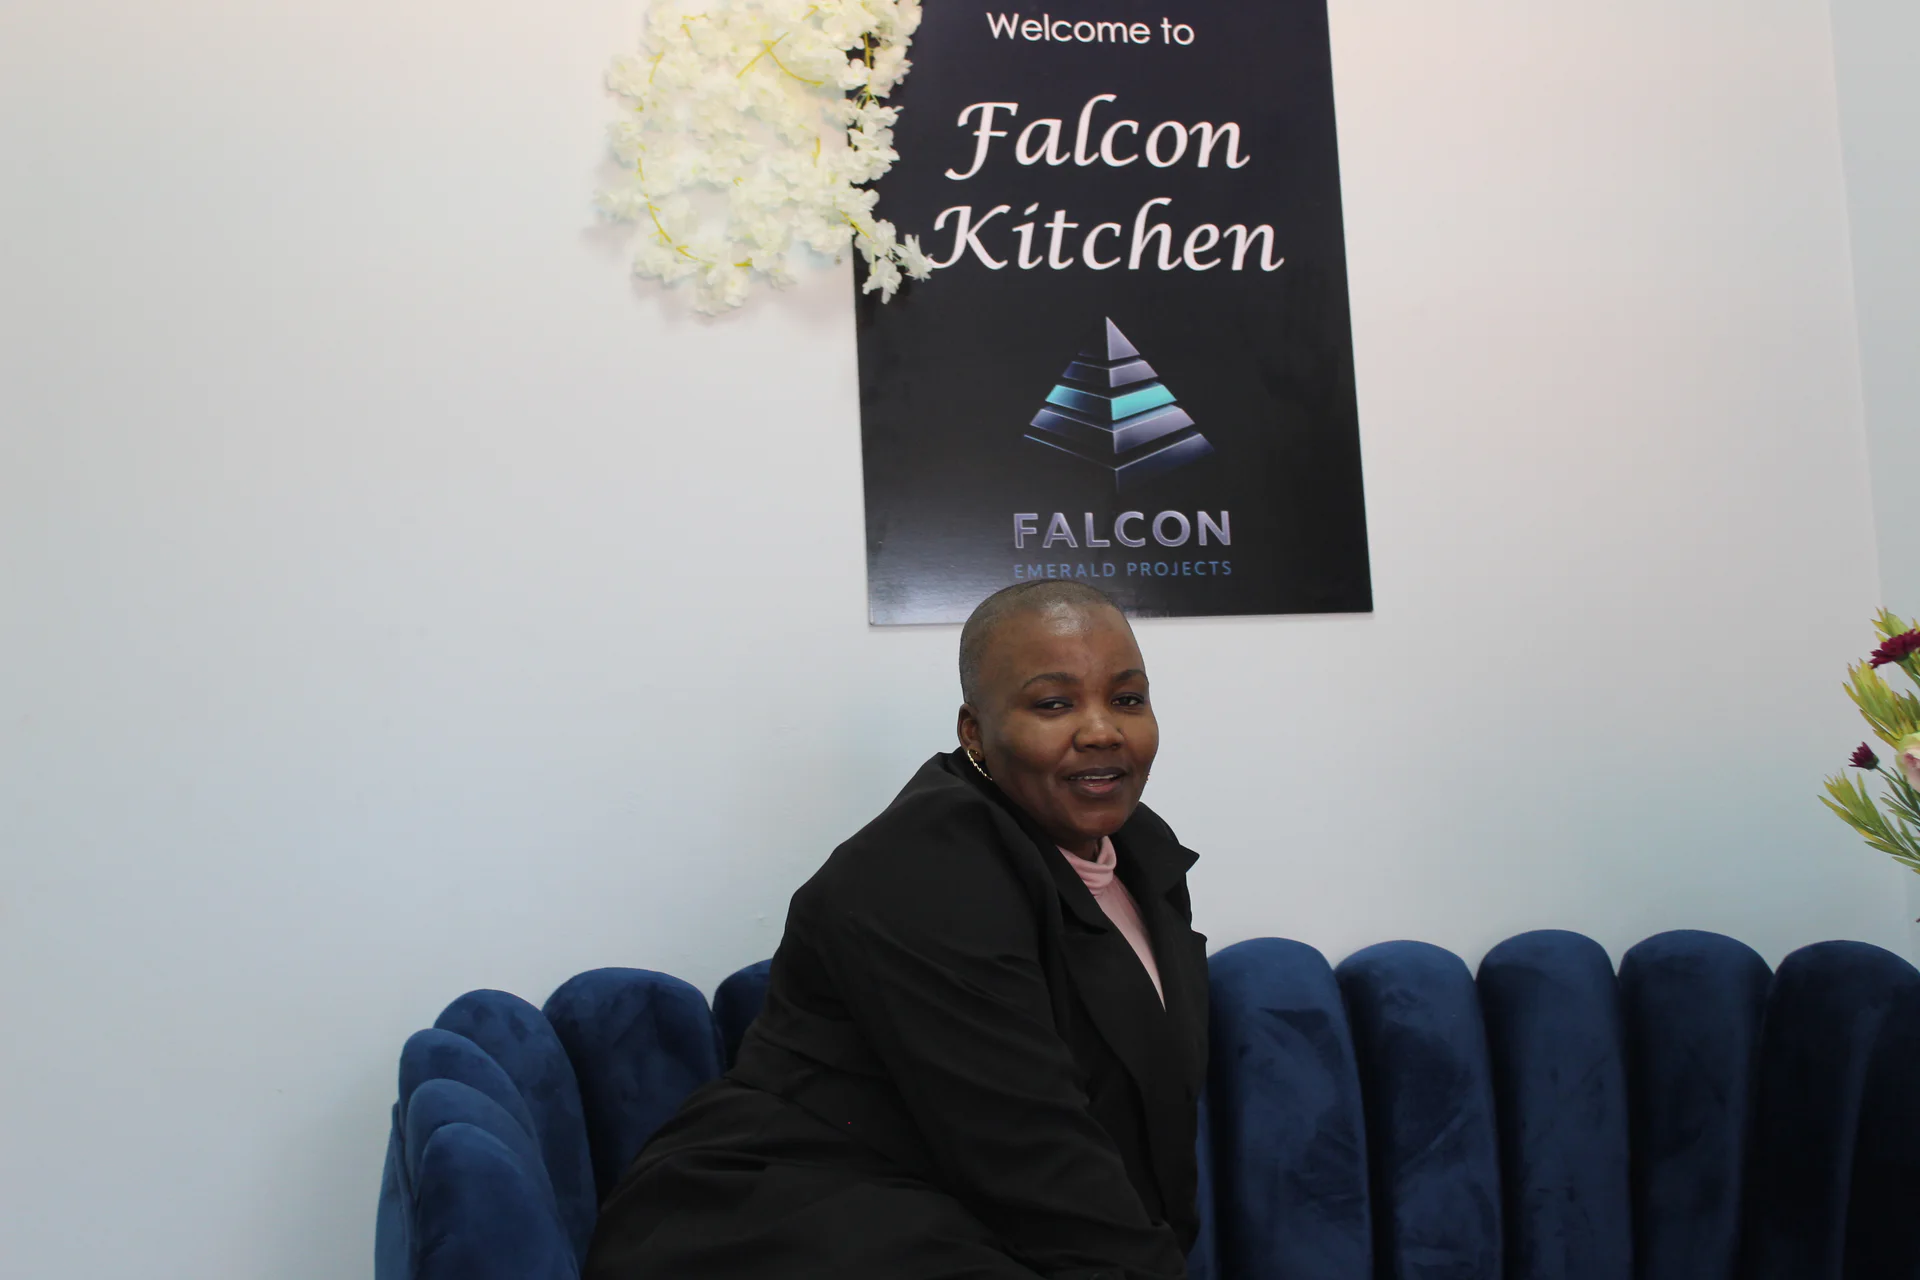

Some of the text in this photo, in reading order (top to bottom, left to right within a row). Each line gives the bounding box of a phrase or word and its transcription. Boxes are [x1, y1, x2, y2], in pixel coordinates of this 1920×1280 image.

[986, 12, 1196, 46] Welcome to
[944, 93, 1251, 181] Falcon
[931, 196, 1285, 272] Kitchen
[1013, 509, 1232, 550] FALCON
[1013, 560, 1233, 579] EMERALD PROJECTS
